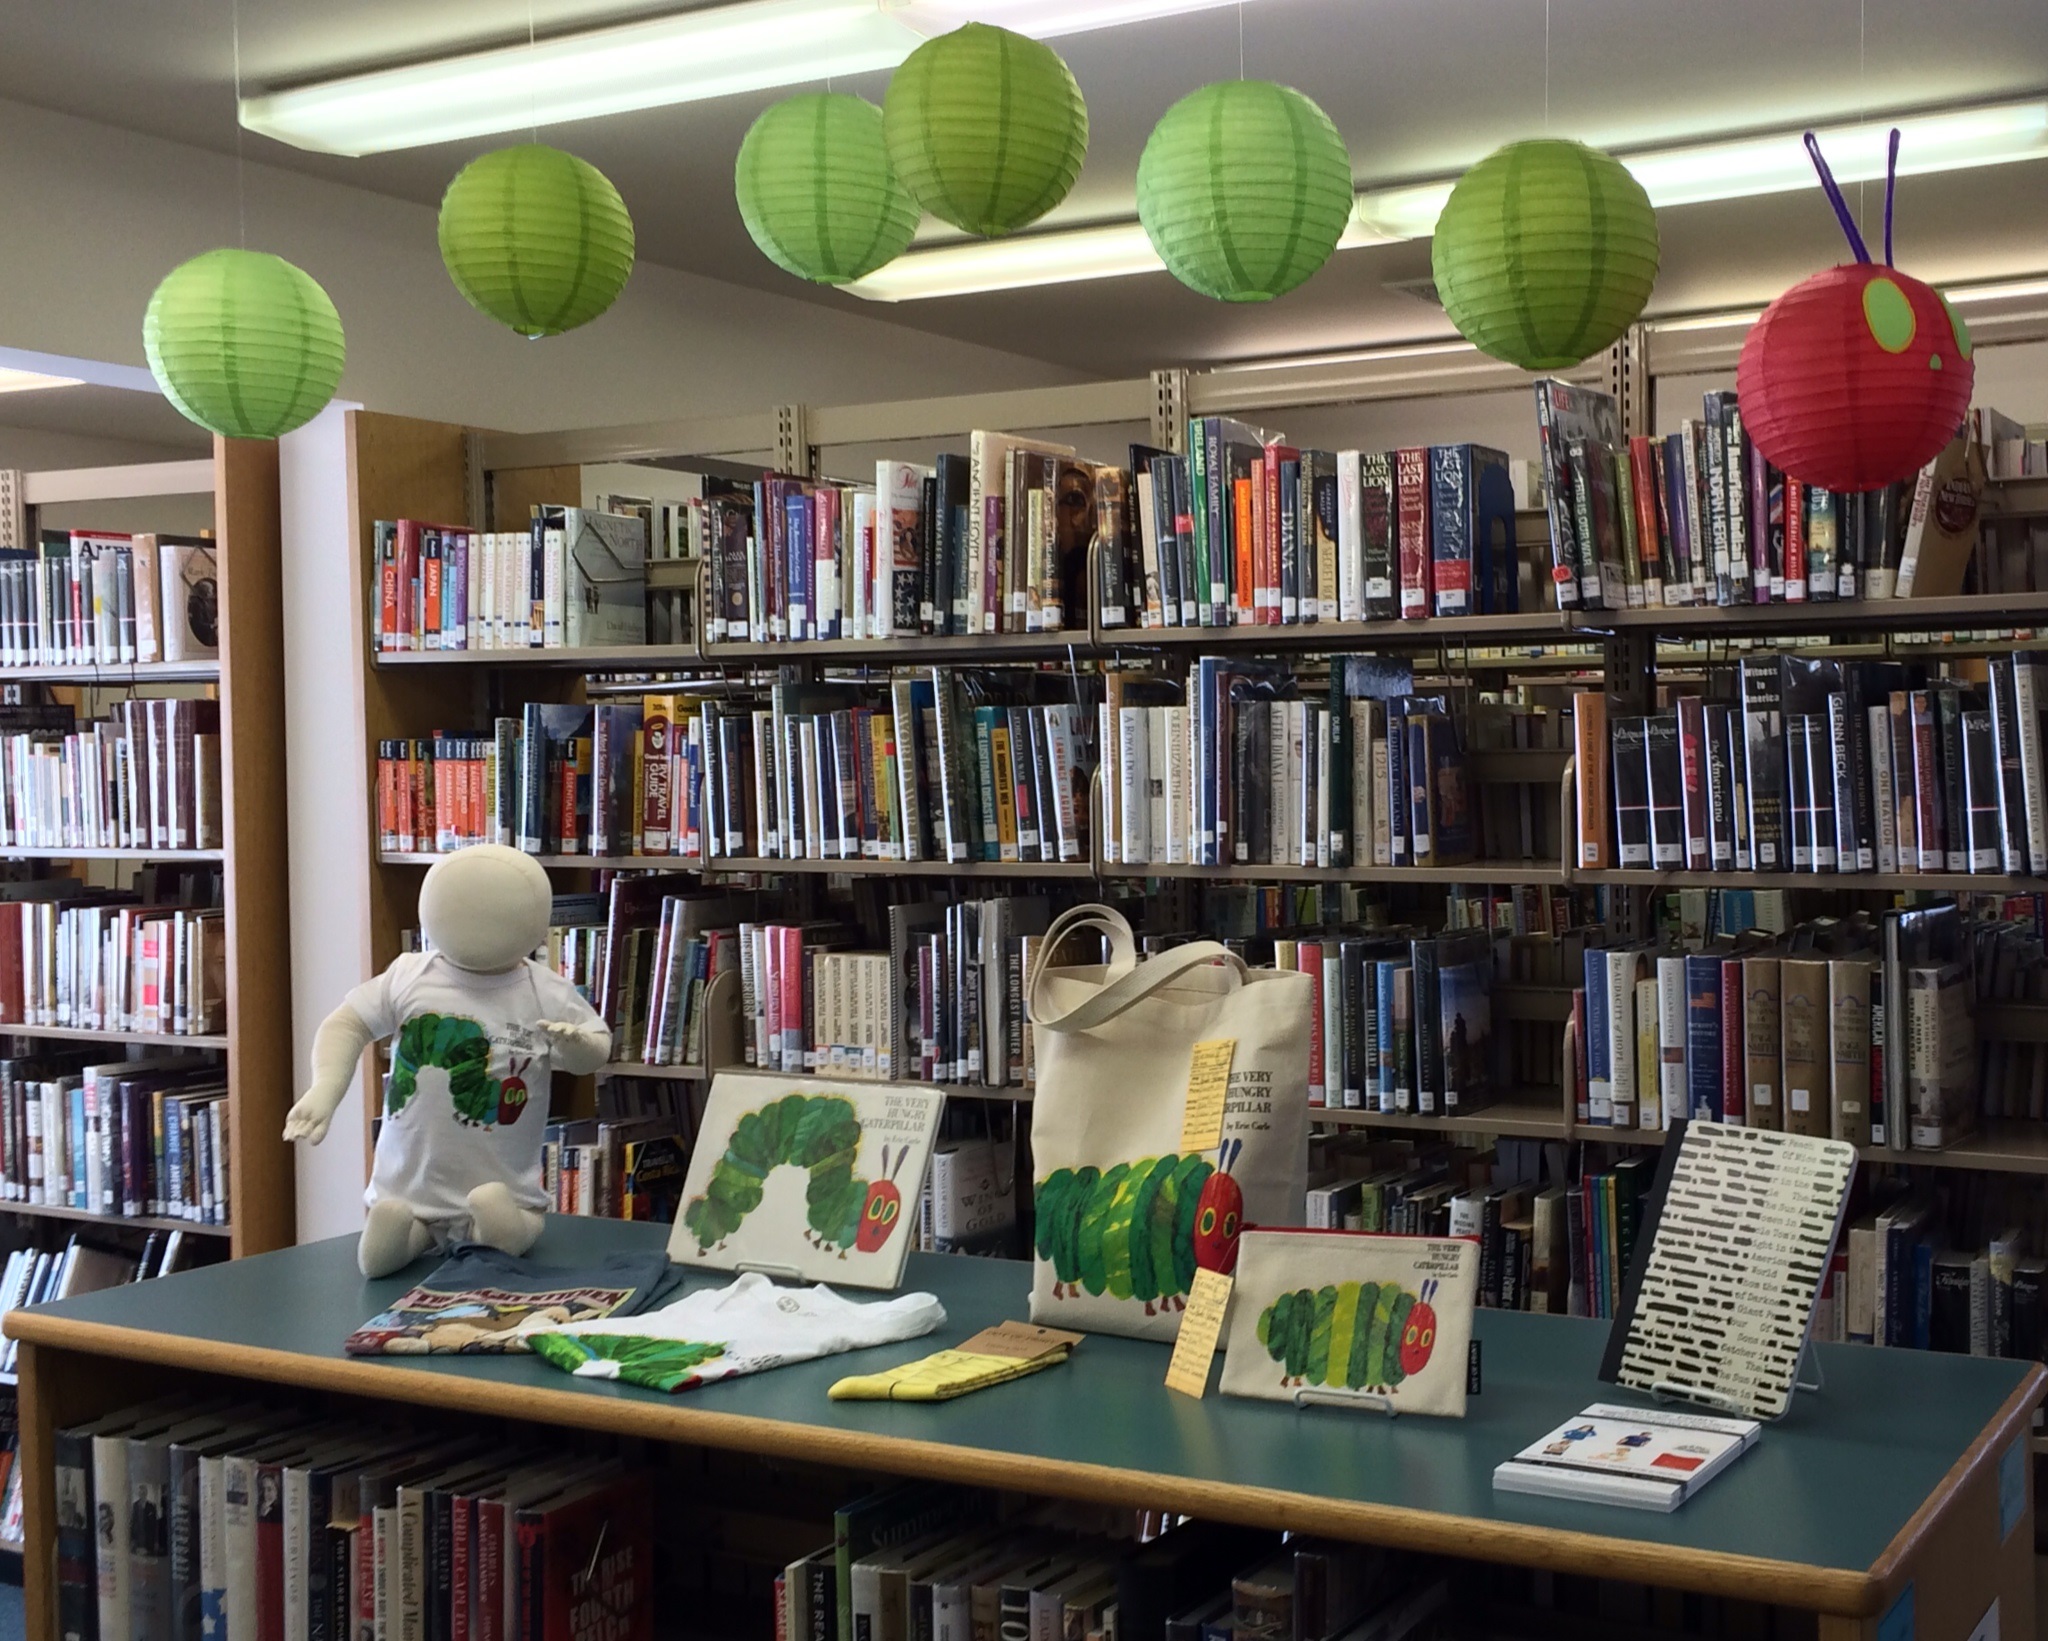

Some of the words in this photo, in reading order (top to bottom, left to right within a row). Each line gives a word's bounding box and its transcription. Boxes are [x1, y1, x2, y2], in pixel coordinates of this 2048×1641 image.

[1282, 511, 1294, 569] DIANA
[385, 570, 394, 608] CHINA
[429, 564, 438, 597] JAPAN
[1332, 716, 1340, 743] DUBLIN
[1832, 697, 1845, 741] GLENN
[1835, 744, 1847, 779] BECK
[1010, 953, 1020, 970] THE
[1010, 974, 1020, 1015] LONGEST
[1010, 1020, 1021, 1055] WINTER
[1872, 1004, 1882, 1045] AMERICAN
[1616, 1036, 1624, 1061] HOPE
[1227, 1087, 1272, 1099] HUNGRY
[1242, 1070, 1273, 1083] VERY
[813, 1571, 824, 1605] THE
